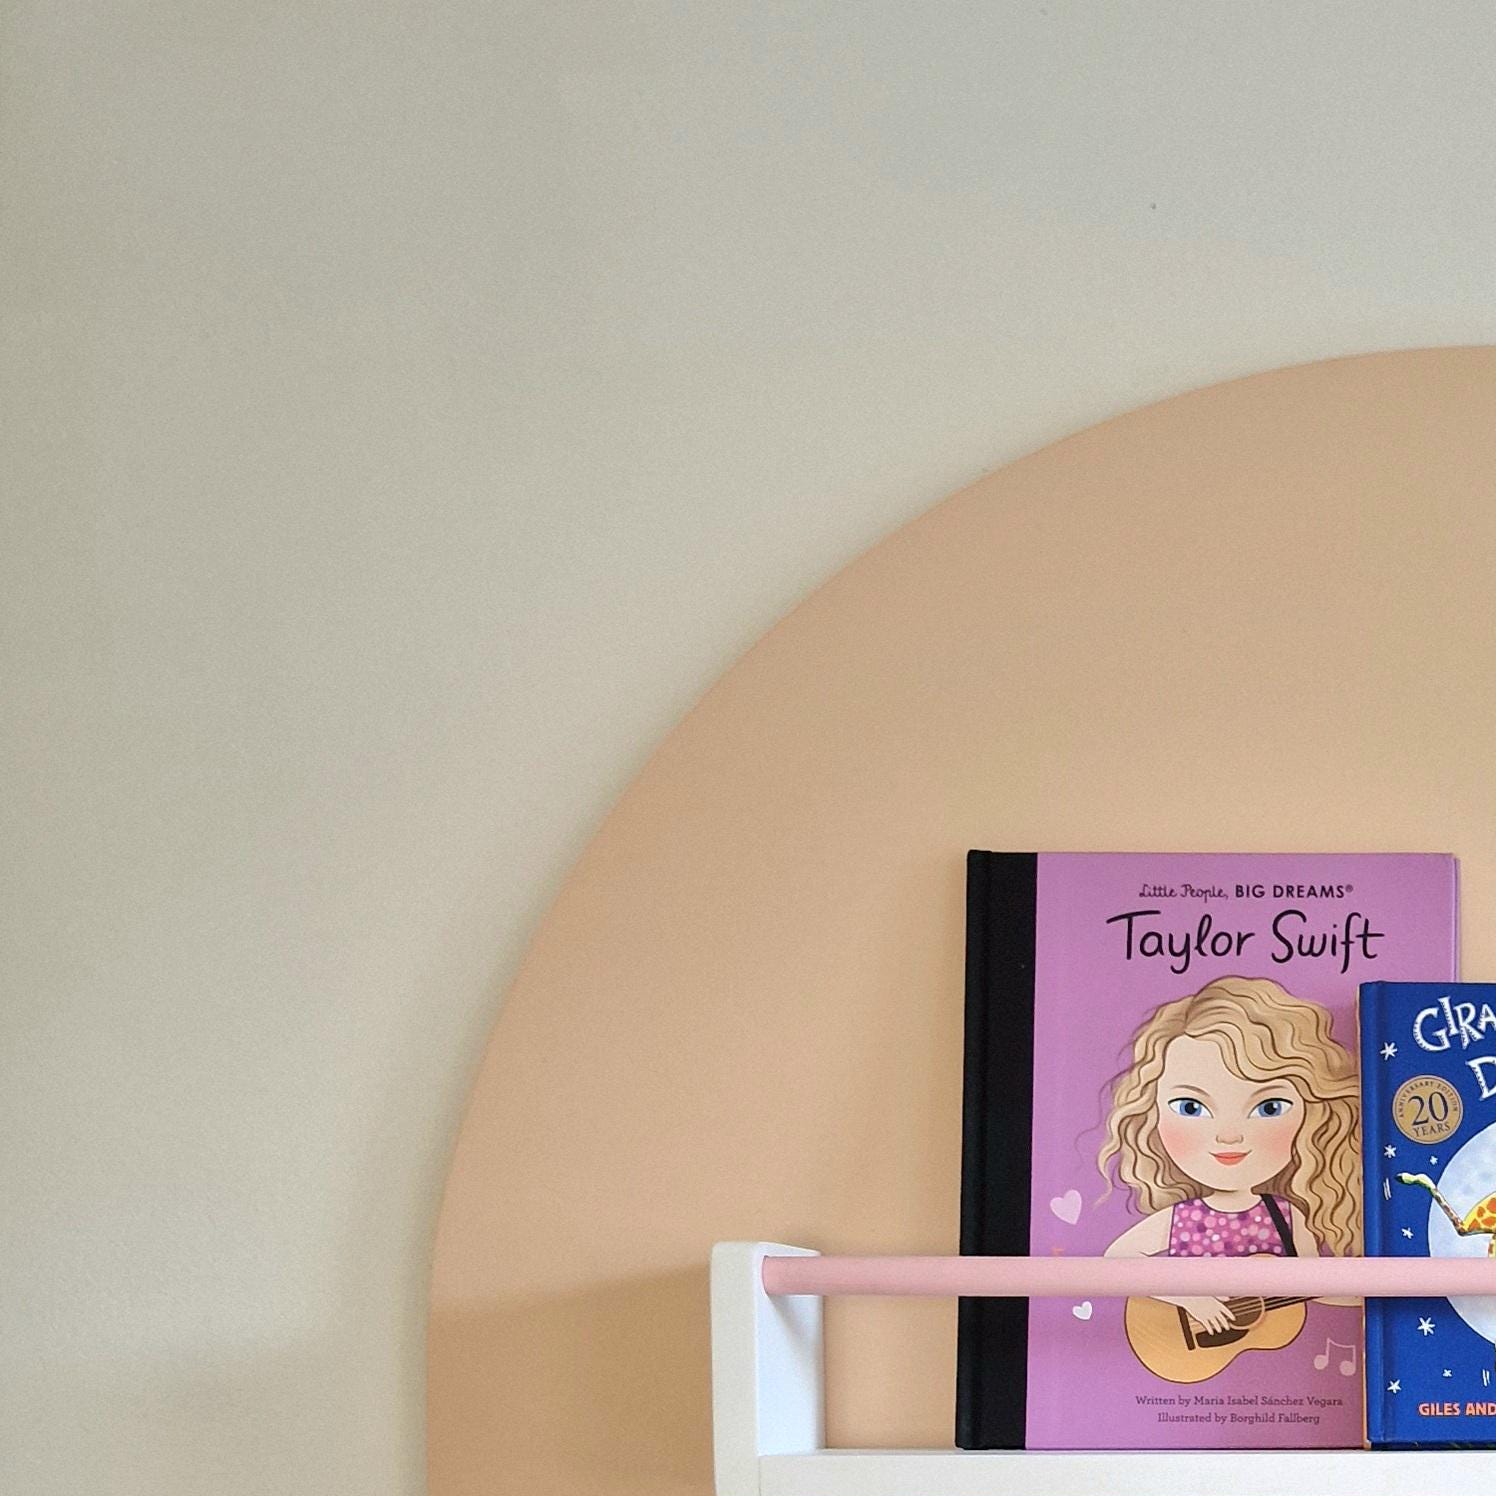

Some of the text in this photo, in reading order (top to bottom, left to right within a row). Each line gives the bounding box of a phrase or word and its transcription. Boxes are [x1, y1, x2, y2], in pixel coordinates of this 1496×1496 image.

[1138, 884, 1178, 898] Little
[1180, 884, 1229, 903] People,
[1235, 884, 1266, 899] BIG
[1105, 908, 1385, 975] Taylor Swift
[1407, 1091, 1449, 1126] 20
[1412, 1122, 1451, 1138] YEARS
[1135, 1394, 1343, 1409] Written by Maria Isabel Sánchez Vegara
[1418, 1402, 1461, 1416] GILES
[1157, 1412, 1320, 1425] Illustrated by Borghild Fallberg
